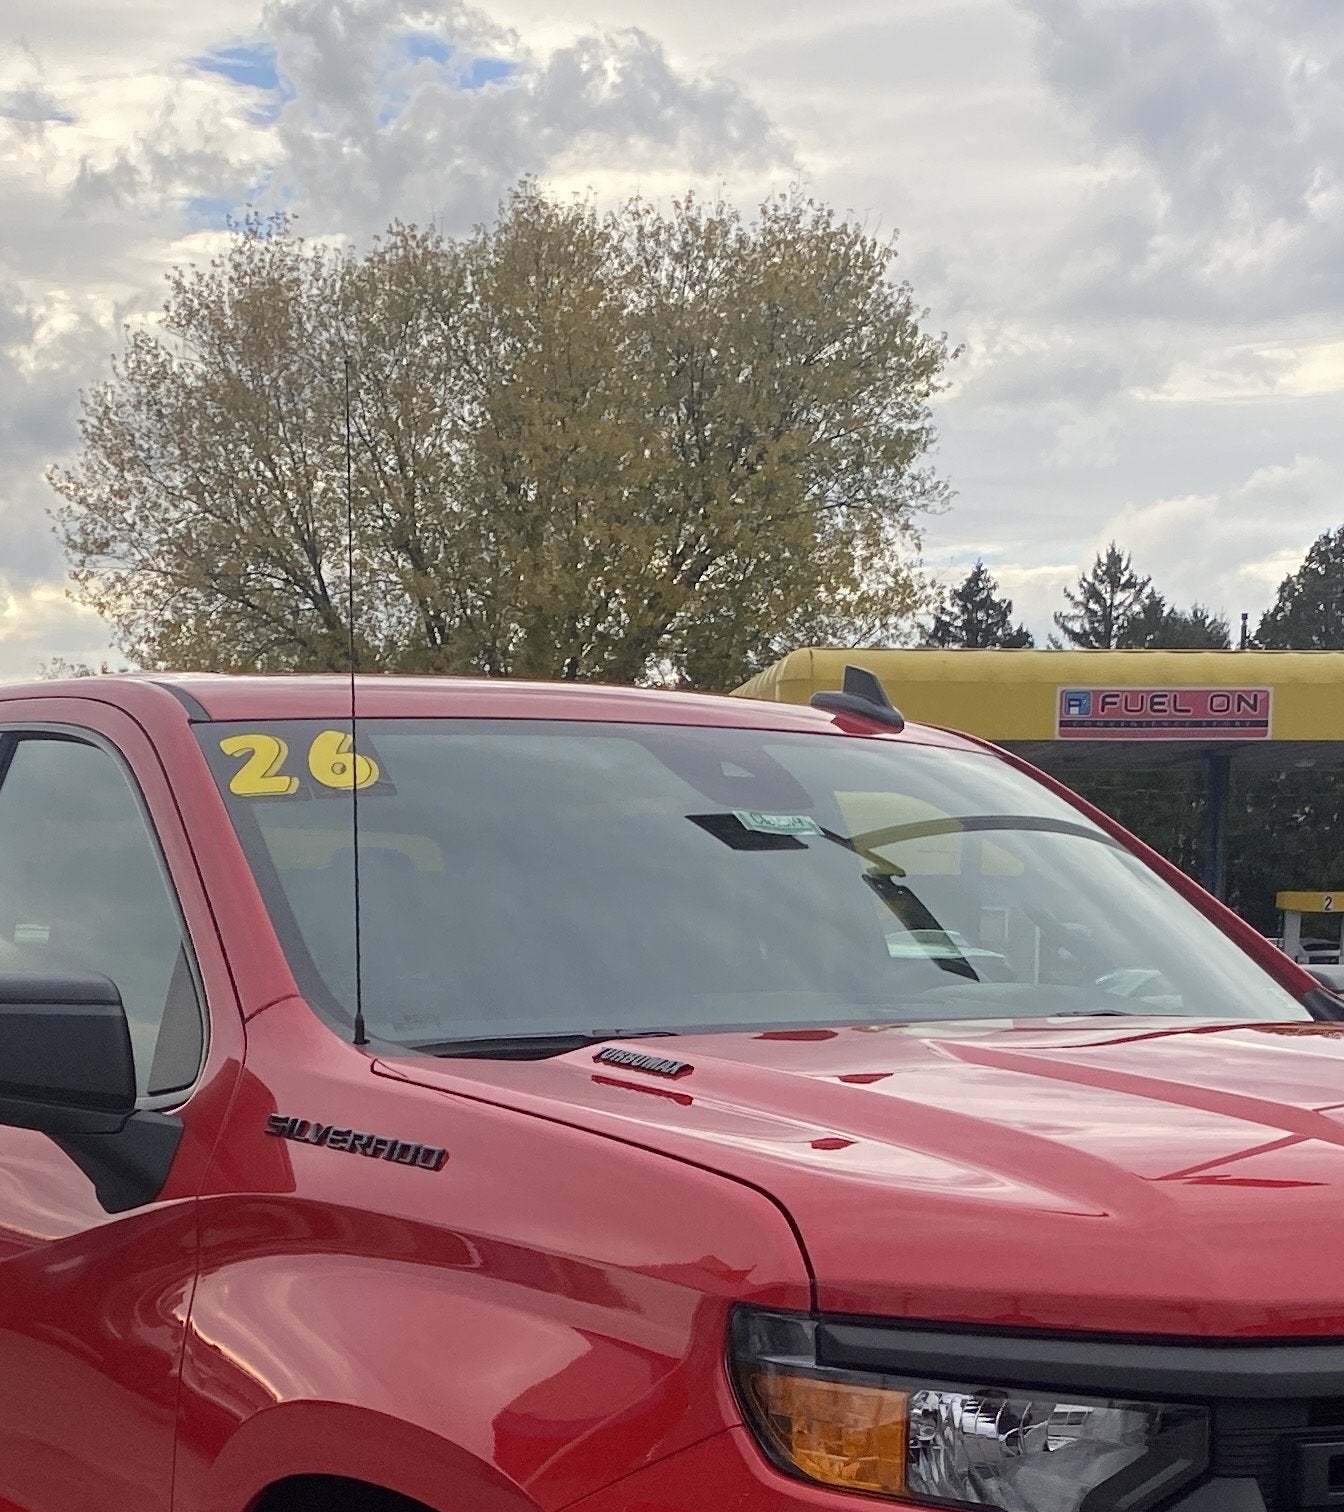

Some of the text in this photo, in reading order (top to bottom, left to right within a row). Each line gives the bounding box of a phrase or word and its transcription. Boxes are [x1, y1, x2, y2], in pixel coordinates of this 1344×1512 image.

[1099, 693, 1258, 713] FUEL ON
[219, 730, 380, 797] 26
[1324, 896, 1333, 911] 2
[265, 1113, 449, 1171] SILVERADO
